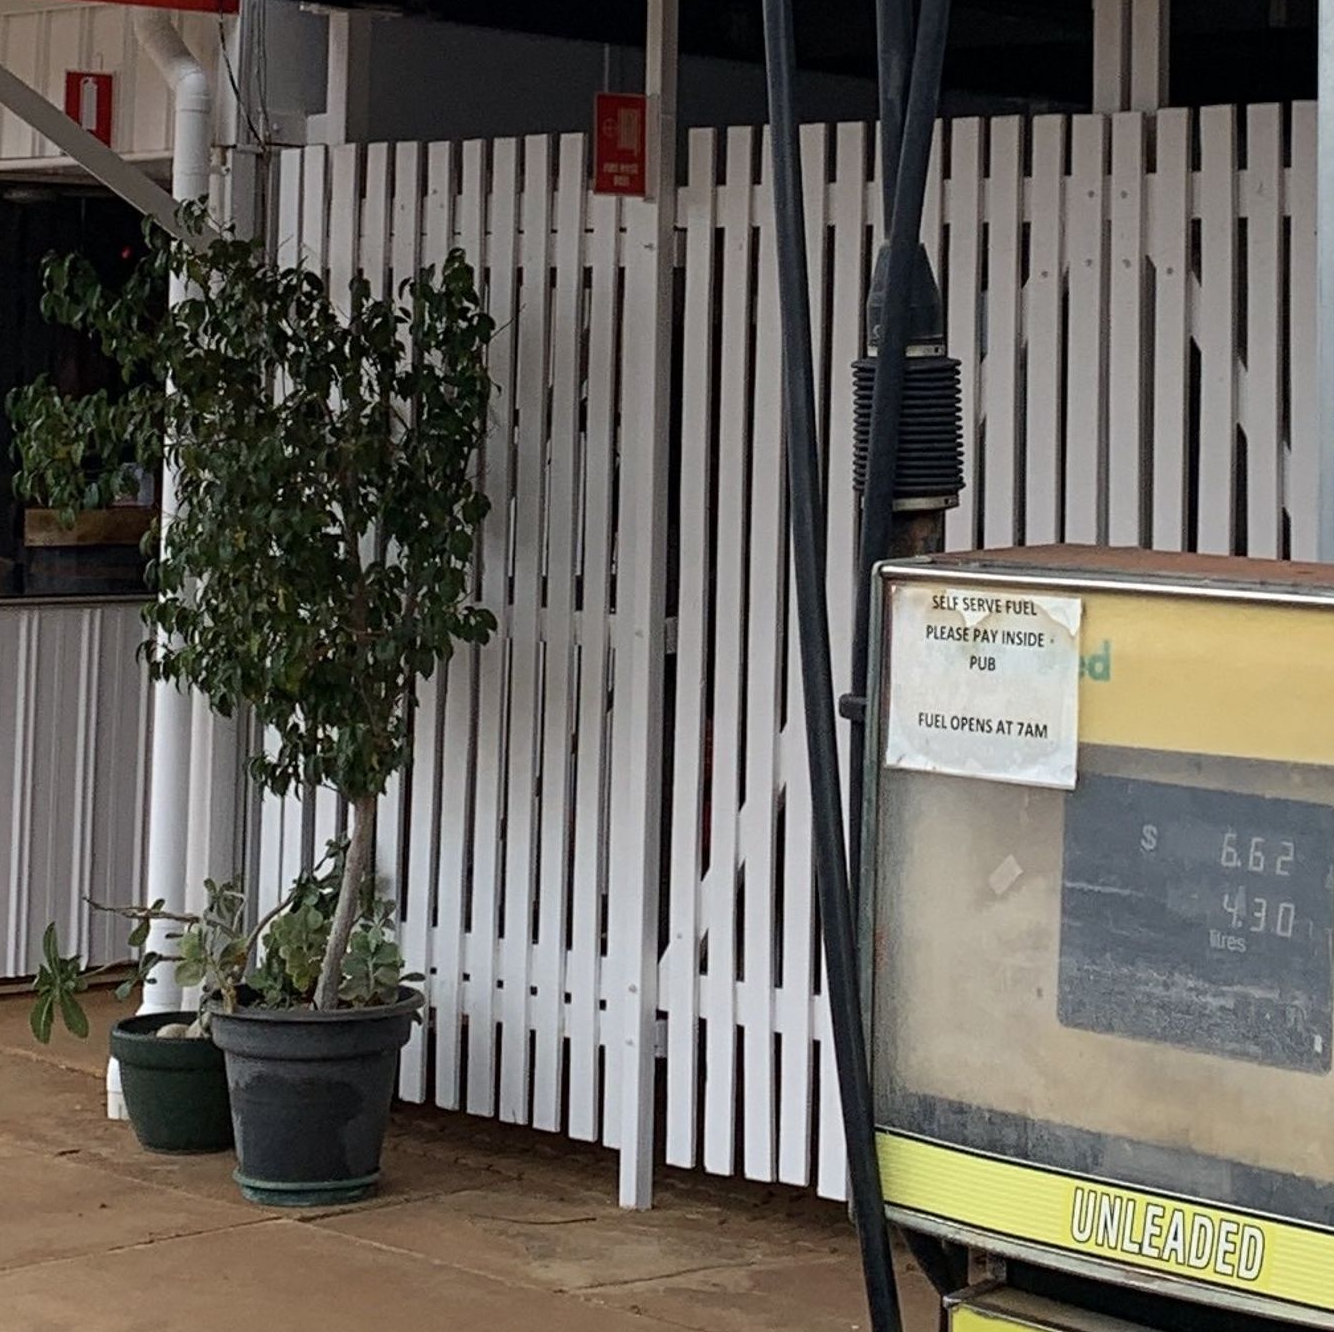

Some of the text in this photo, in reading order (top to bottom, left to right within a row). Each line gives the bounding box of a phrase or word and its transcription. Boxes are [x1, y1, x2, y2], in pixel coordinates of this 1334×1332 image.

[932, 594, 1038, 617] SELF SERVE FUEL
[925, 624, 1046, 648] PLEASE PAY INSIDE
[969, 655, 997, 672] PUB
[918, 711, 1049, 740] FUEL OPENS AT 7AM
[1220, 831, 1295, 877] 6.62
[1070, 1186, 1266, 1282] UNLEADED
